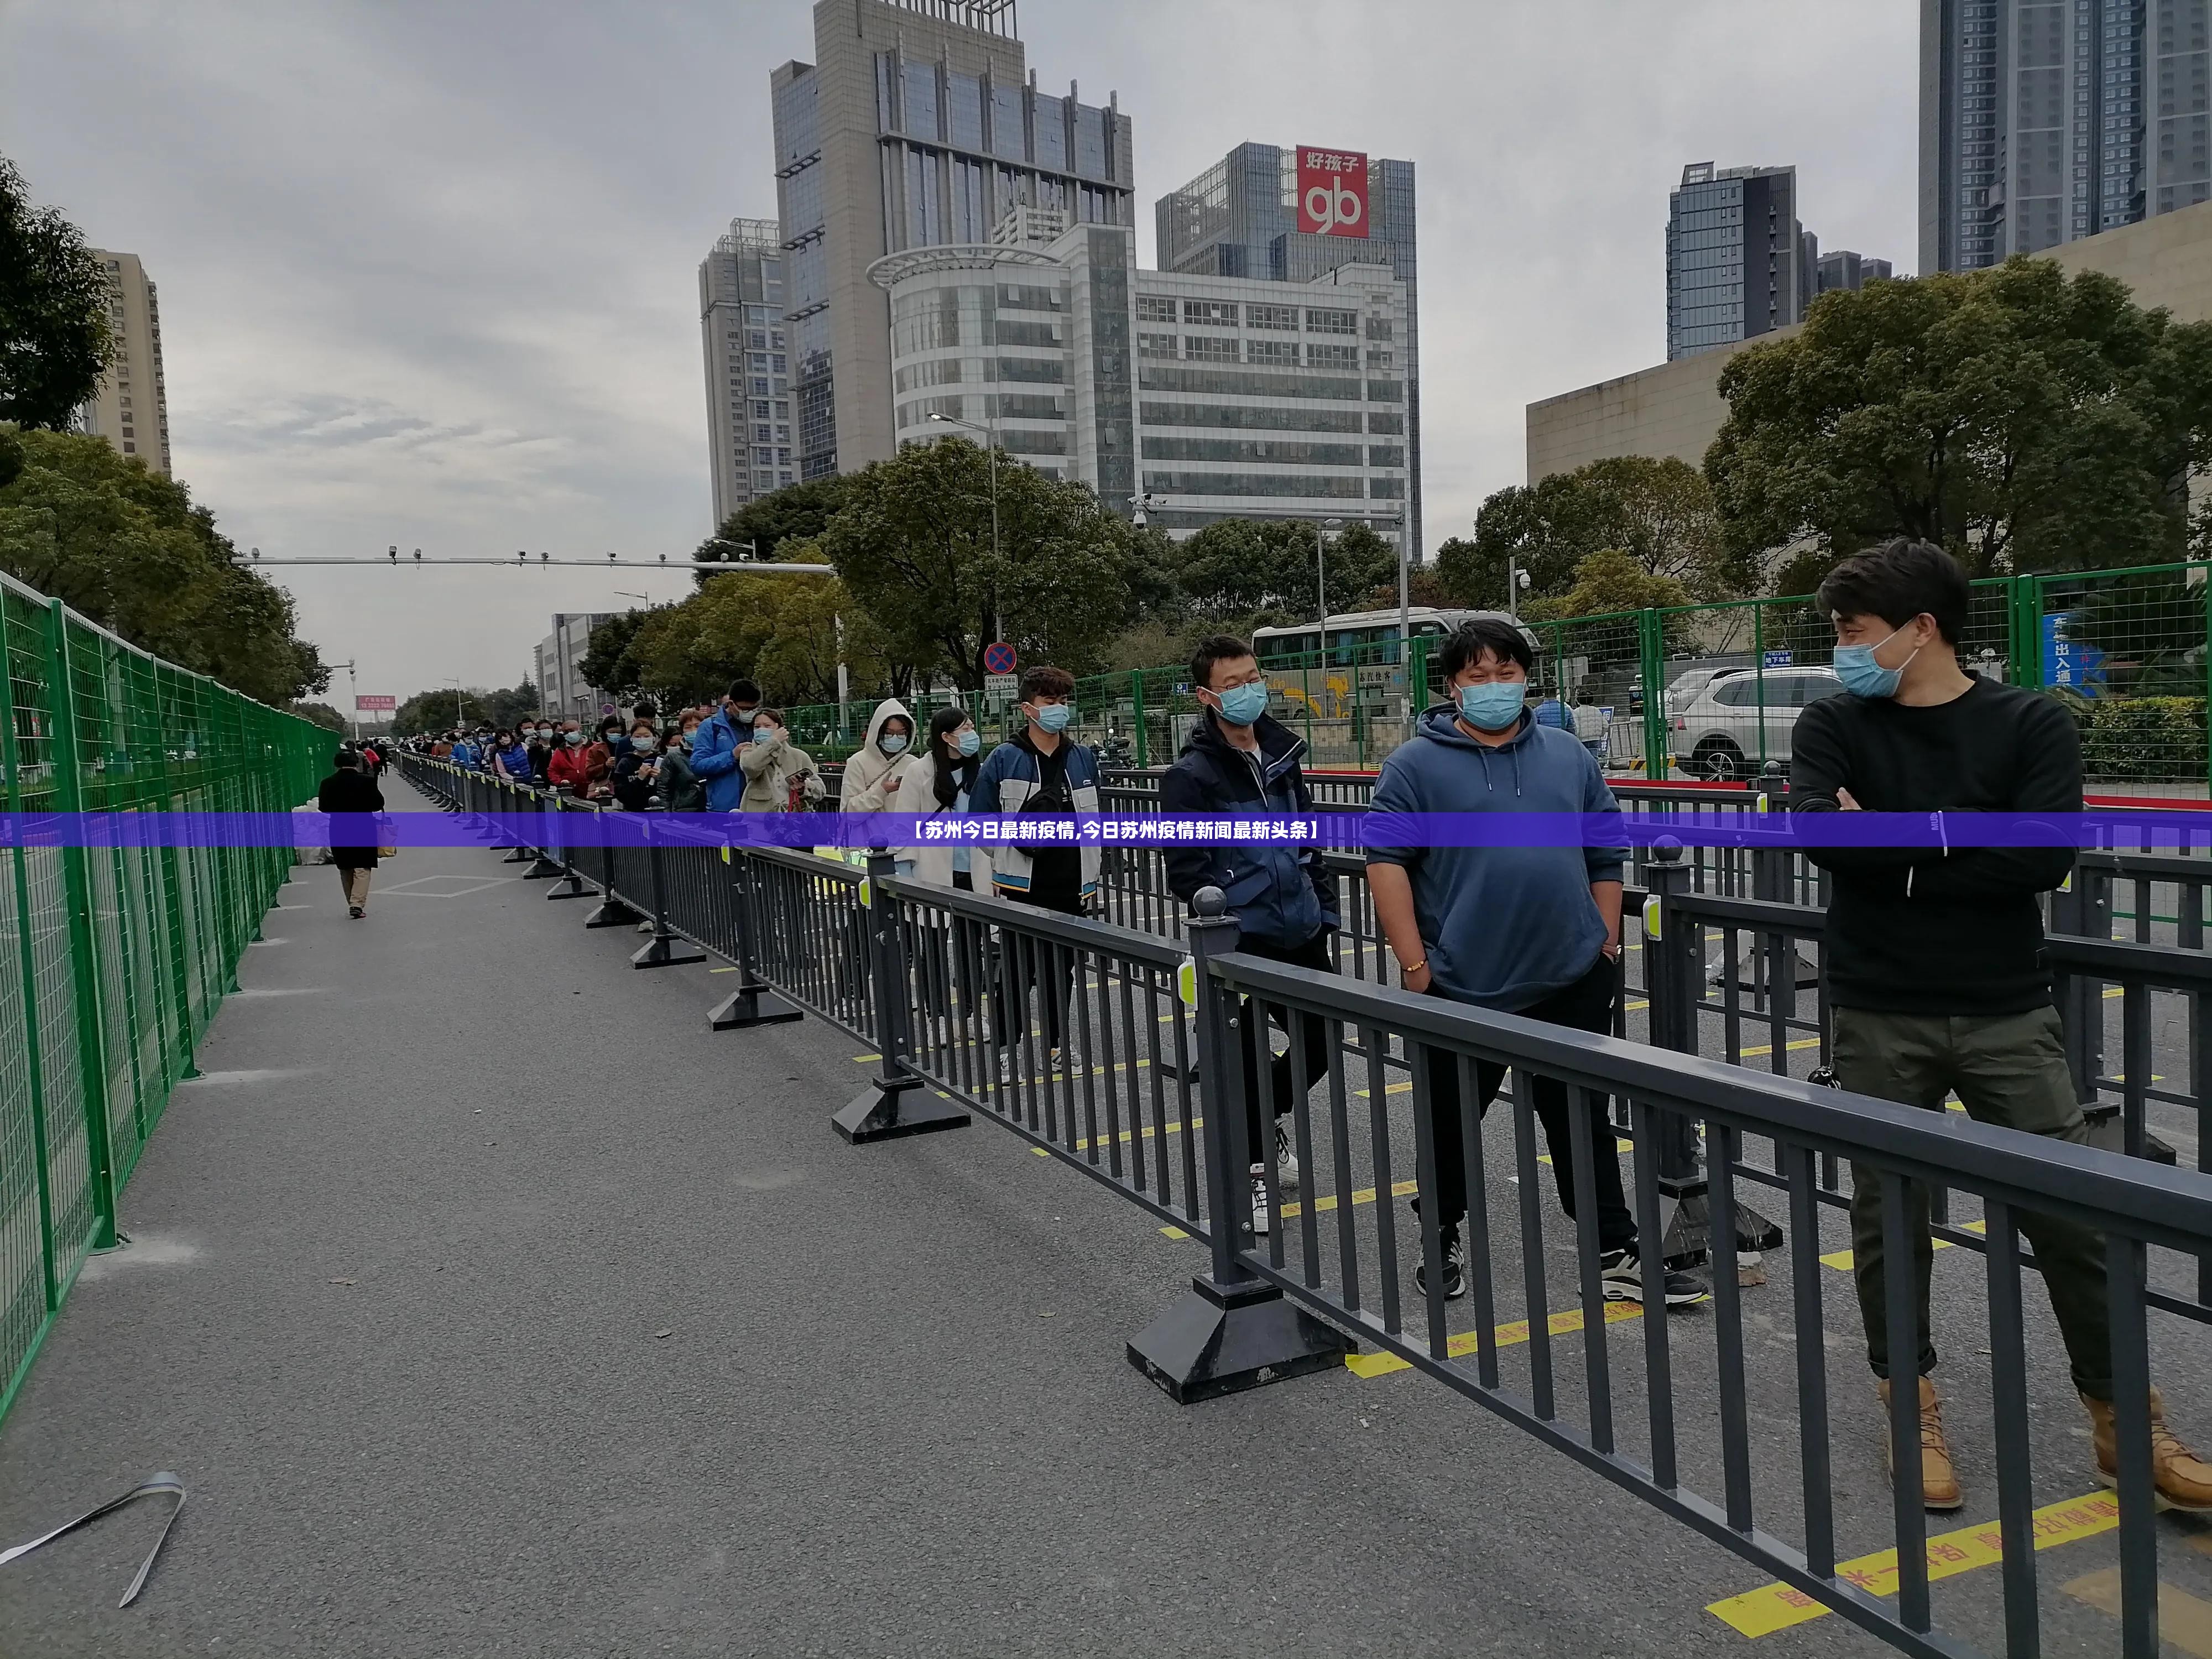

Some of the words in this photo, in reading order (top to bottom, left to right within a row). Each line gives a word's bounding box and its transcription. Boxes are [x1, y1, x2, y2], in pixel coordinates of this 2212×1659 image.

[1306, 152, 1359, 173] 好孩子
[1305, 175, 1361, 233] gb
